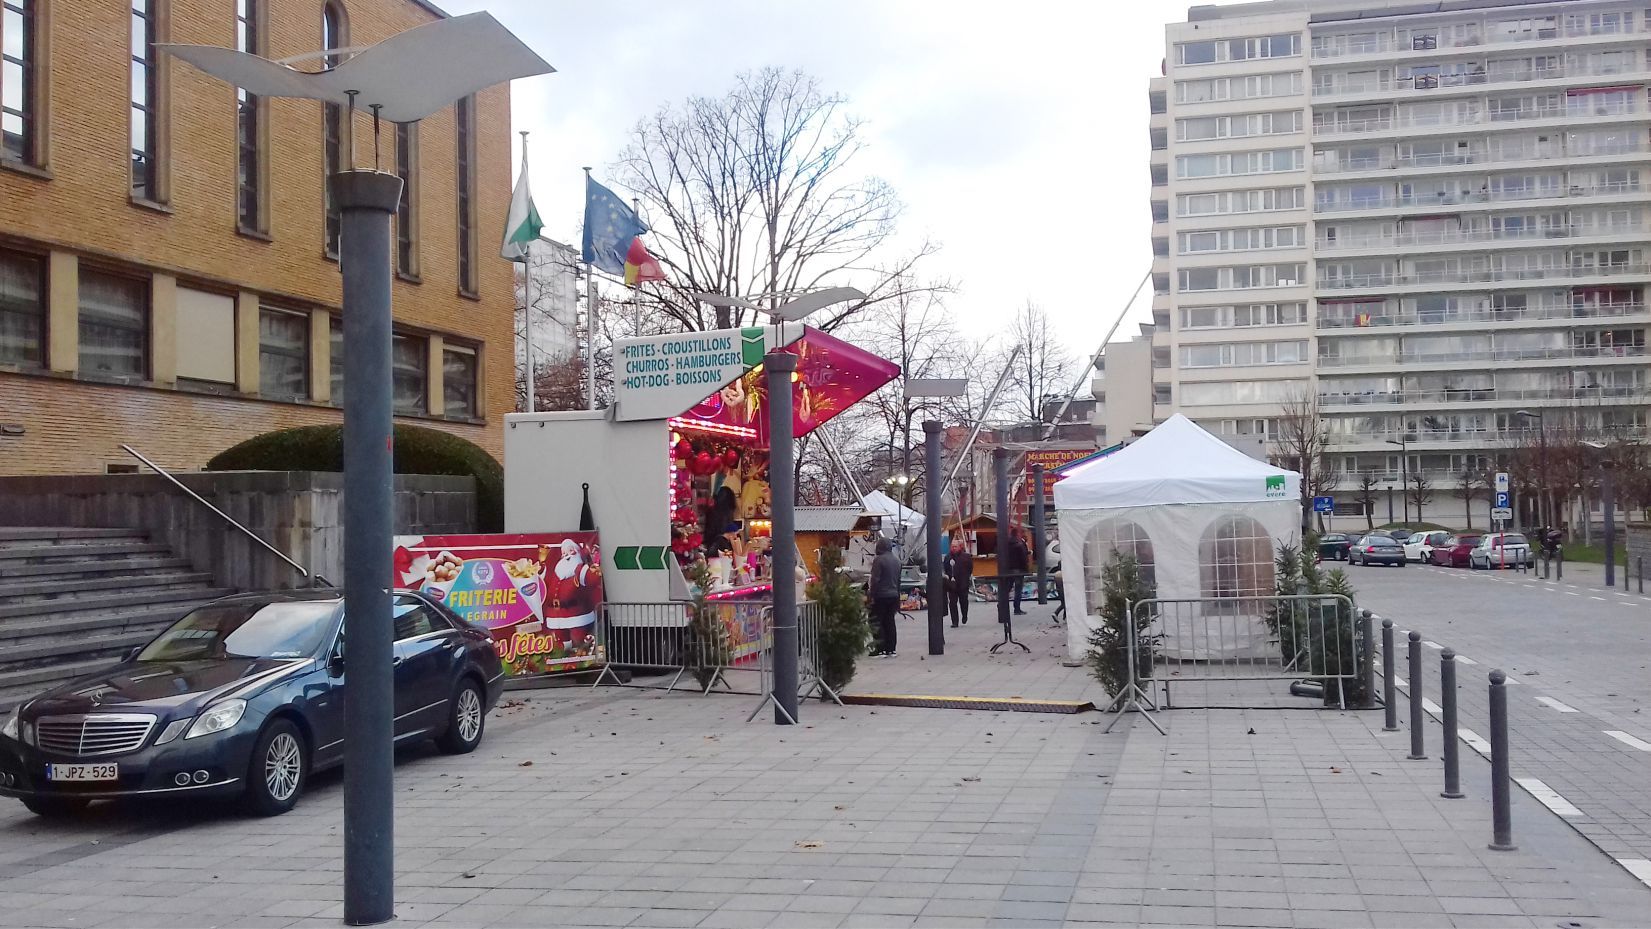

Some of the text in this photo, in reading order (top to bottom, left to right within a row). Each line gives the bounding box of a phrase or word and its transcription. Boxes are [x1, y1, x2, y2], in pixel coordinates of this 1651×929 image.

[625, 337, 732, 358] FRITES CROUSTILLONS
[626, 352, 741, 373] CHURROS HAMBURGERS
[626, 369, 722, 389] HOT-DOG BOISSONS
[449, 588, 518, 608] FRITERIE
